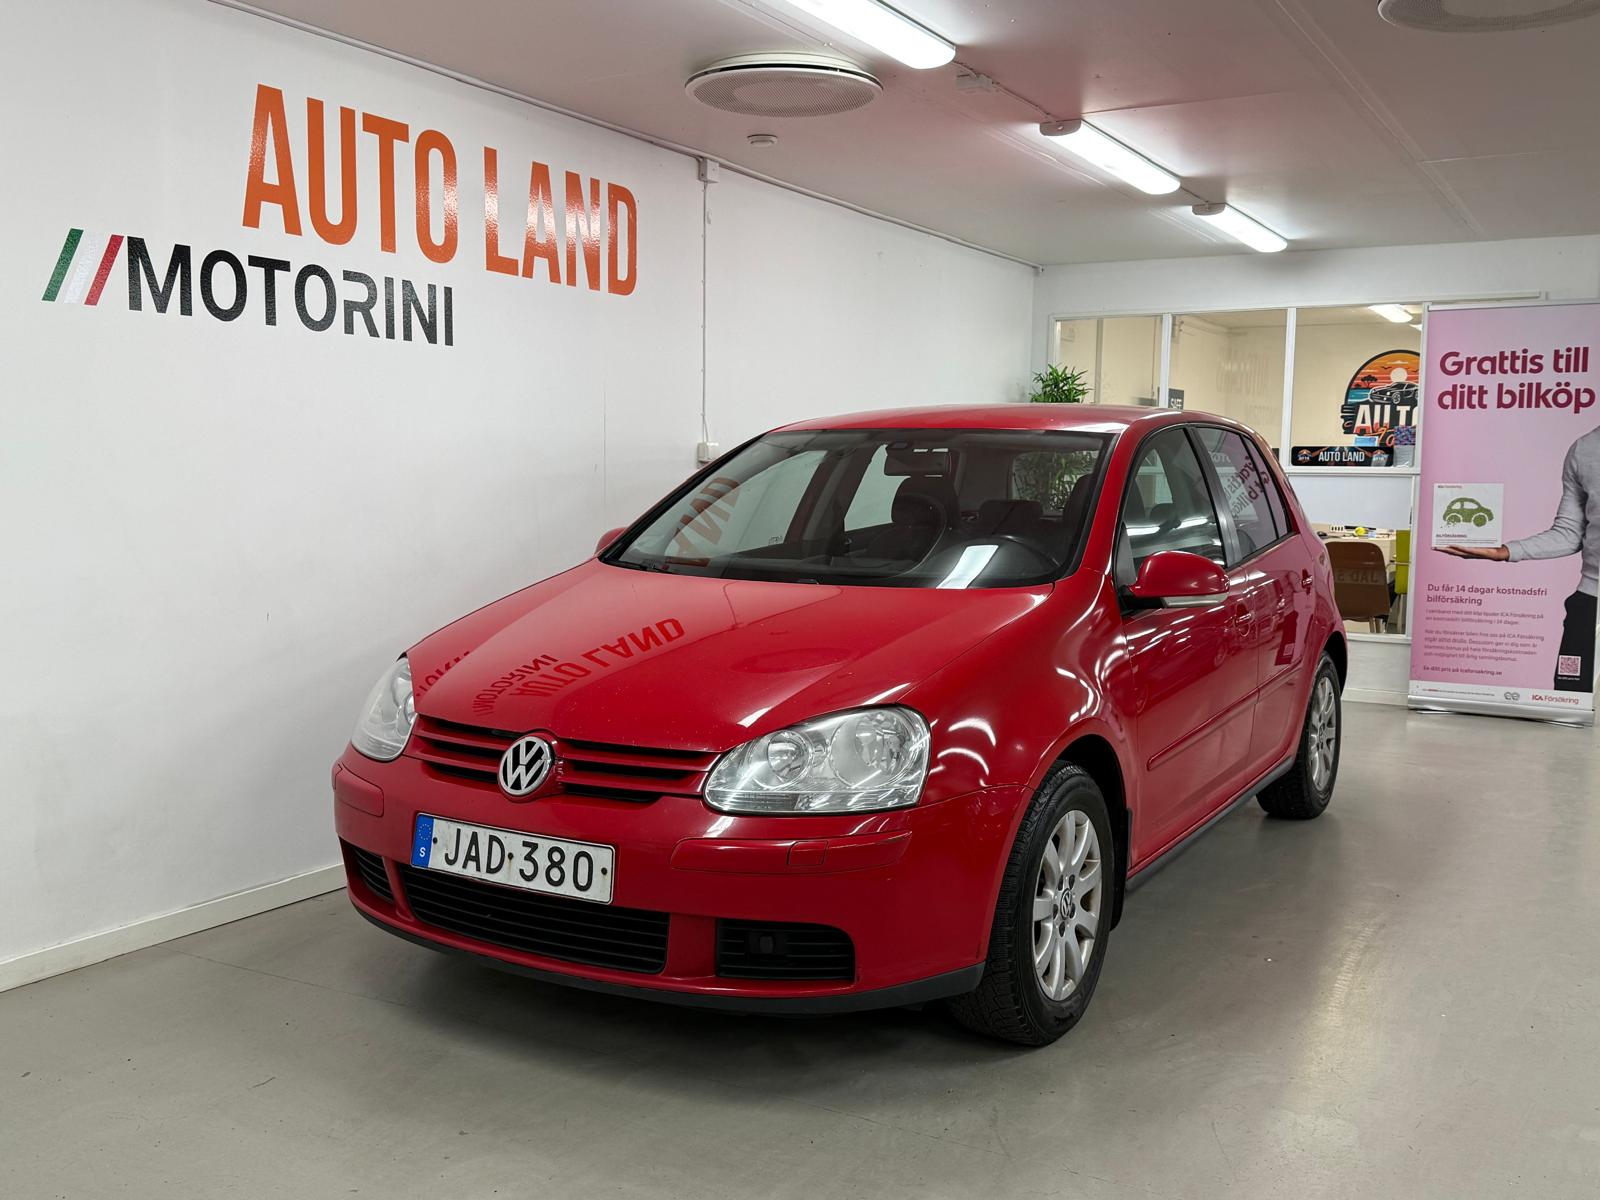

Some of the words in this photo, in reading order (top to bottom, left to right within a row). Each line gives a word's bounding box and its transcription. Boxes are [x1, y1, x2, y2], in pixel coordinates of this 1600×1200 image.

[242, 83, 458, 264] AUTO
[484, 146, 638, 296] LAND
[126, 235, 454, 346] MOTORINI
[1439, 348, 1544, 376] Grattis
[1553, 346, 1589, 373] till
[1437, 383, 1488, 410] ditt
[1496, 381, 1596, 414] bilköp
[1318, 451, 1340, 462] AUTO
[1342, 451, 1365, 462] LAND
[1427, 583, 1440, 592] Du
[1441, 584, 1454, 593] får
[1456, 585, 1466, 593] 14
[1467, 585, 1495, 595] dagar
[1496, 586, 1547, 596] kostnadsfri
[1426, 595, 1483, 606] bilförsäkring
[1531, 693, 1544, 702] ICA
[1544, 694, 1580, 705] Försäkring
[419, 847, 426, 858] S
[444, 828, 506, 874] JAD
[519, 840, 593, 892] 380
